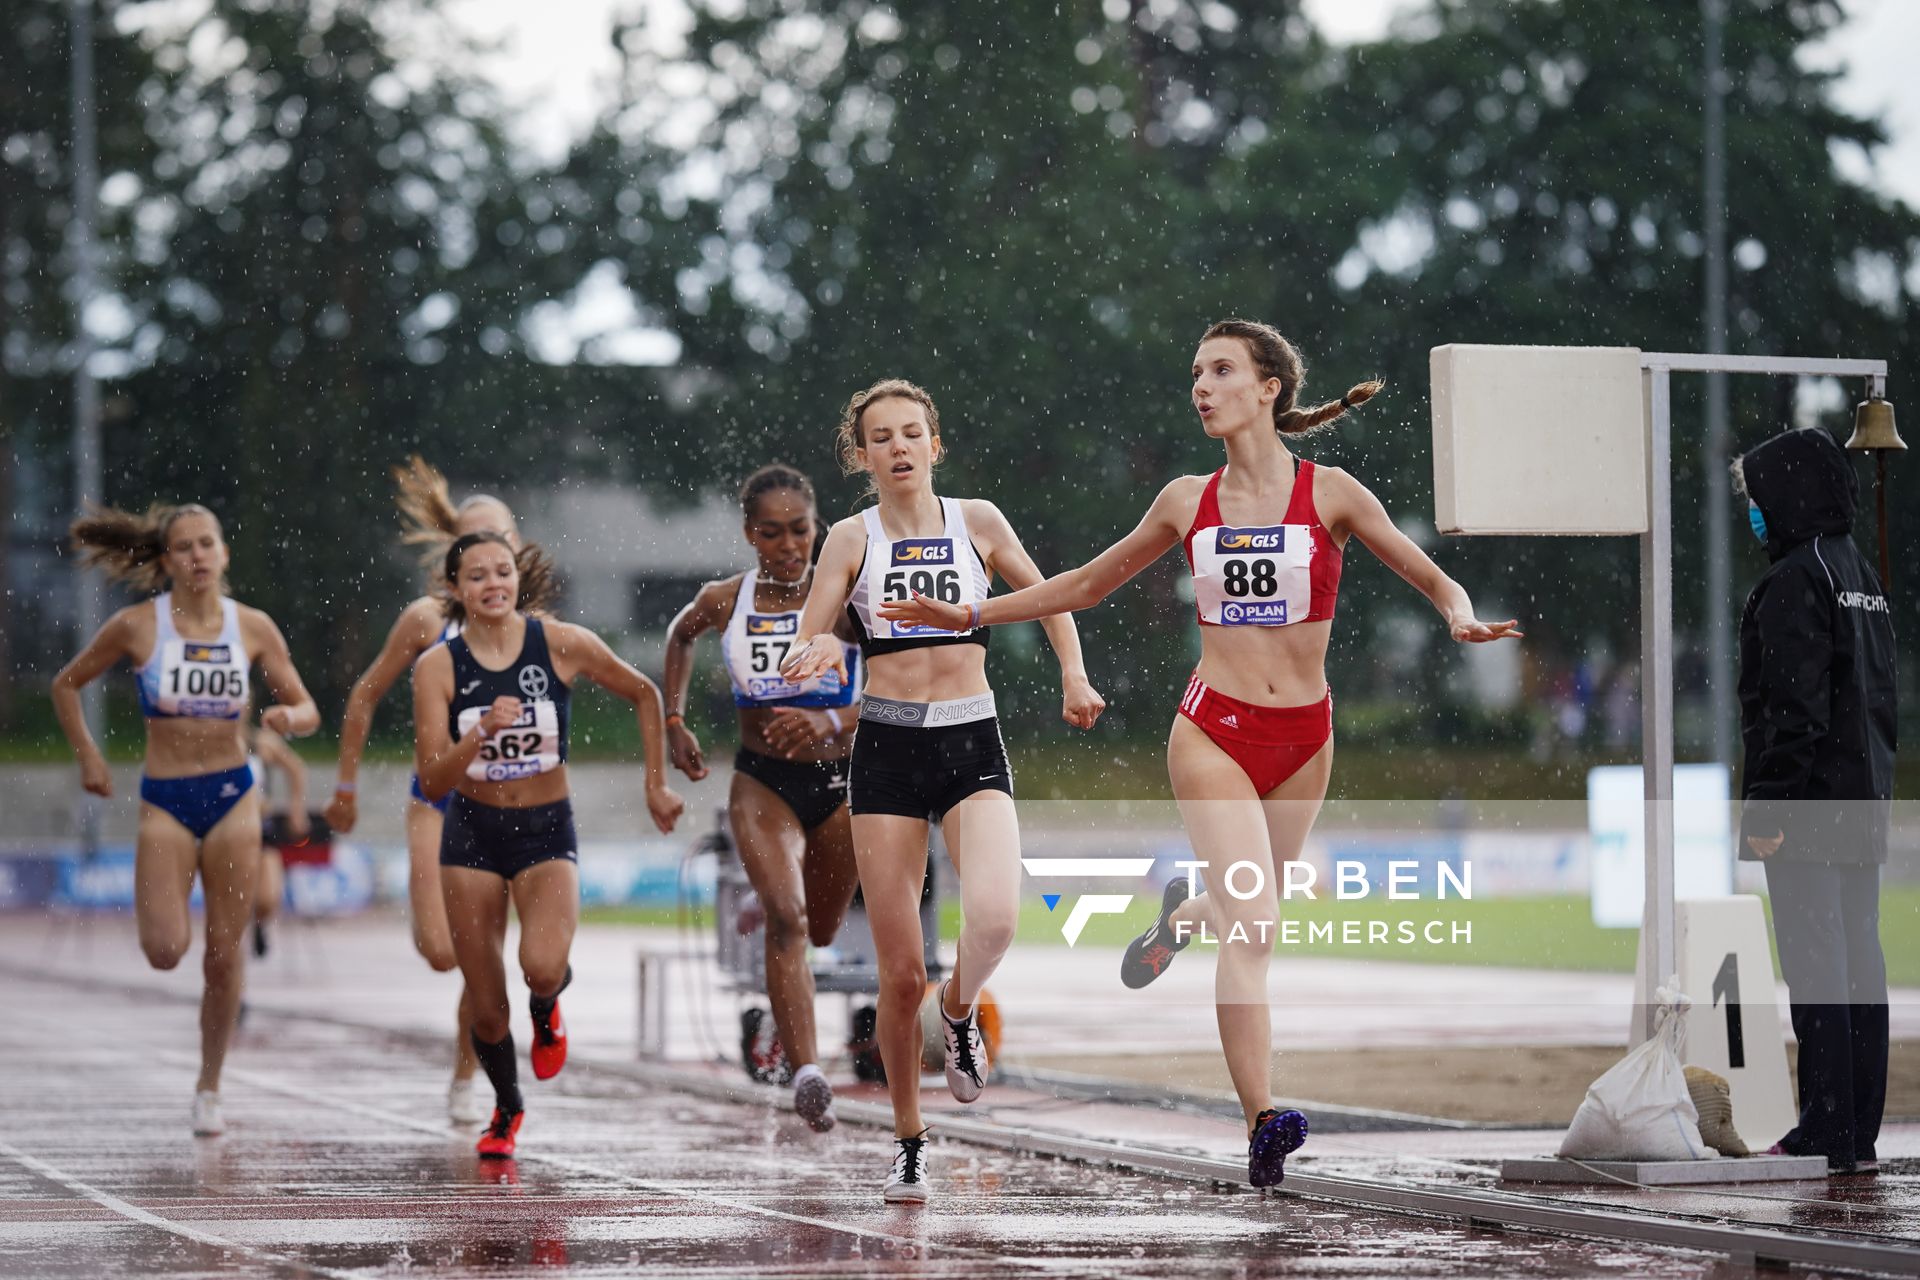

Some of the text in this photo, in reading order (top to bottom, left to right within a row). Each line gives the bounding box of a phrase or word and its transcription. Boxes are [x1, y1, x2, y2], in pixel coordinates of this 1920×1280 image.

[922, 545, 948, 560] GLS
[1251, 534, 1279, 548] GLS
[884, 569, 960, 604] 596
[1224, 559, 1278, 597] 88
[1246, 606, 1284, 616] PLAN
[169, 667, 243, 697] 1005
[863, 702, 920, 721] PRO
[933, 697, 992, 722] NIKE
[480, 733, 542, 761] 562
[1712, 953, 1745, 1068] 1
